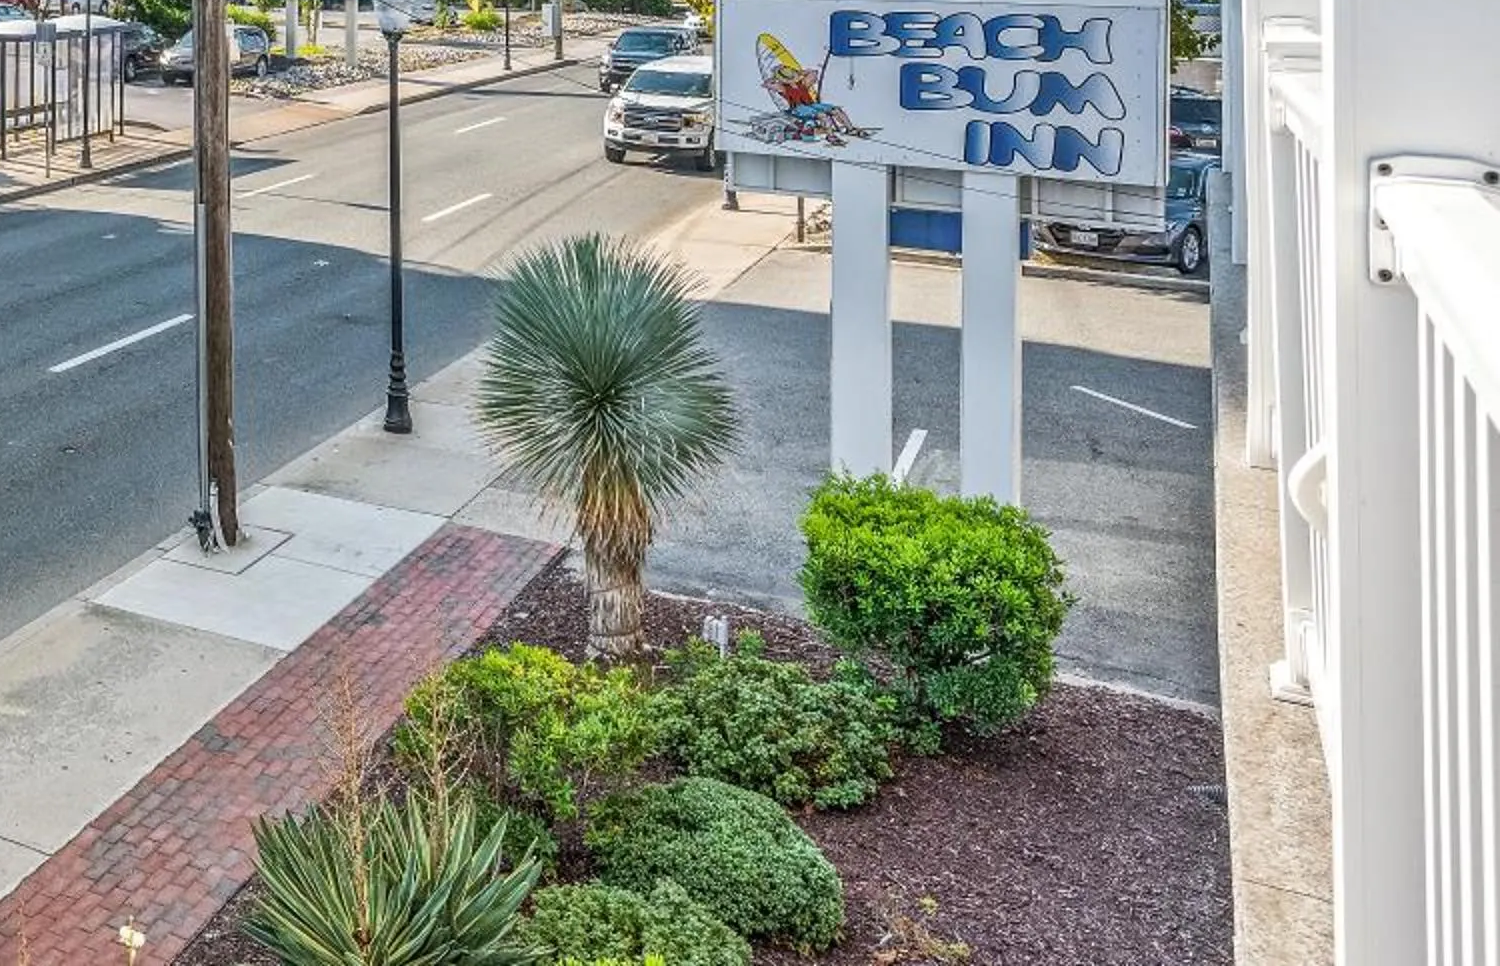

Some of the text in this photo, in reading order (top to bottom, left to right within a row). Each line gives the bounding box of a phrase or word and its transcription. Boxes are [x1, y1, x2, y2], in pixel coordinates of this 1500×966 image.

[828, 9, 1114, 65] BEACH
[899, 62, 1127, 121] BUM
[963, 119, 1126, 177] INN
